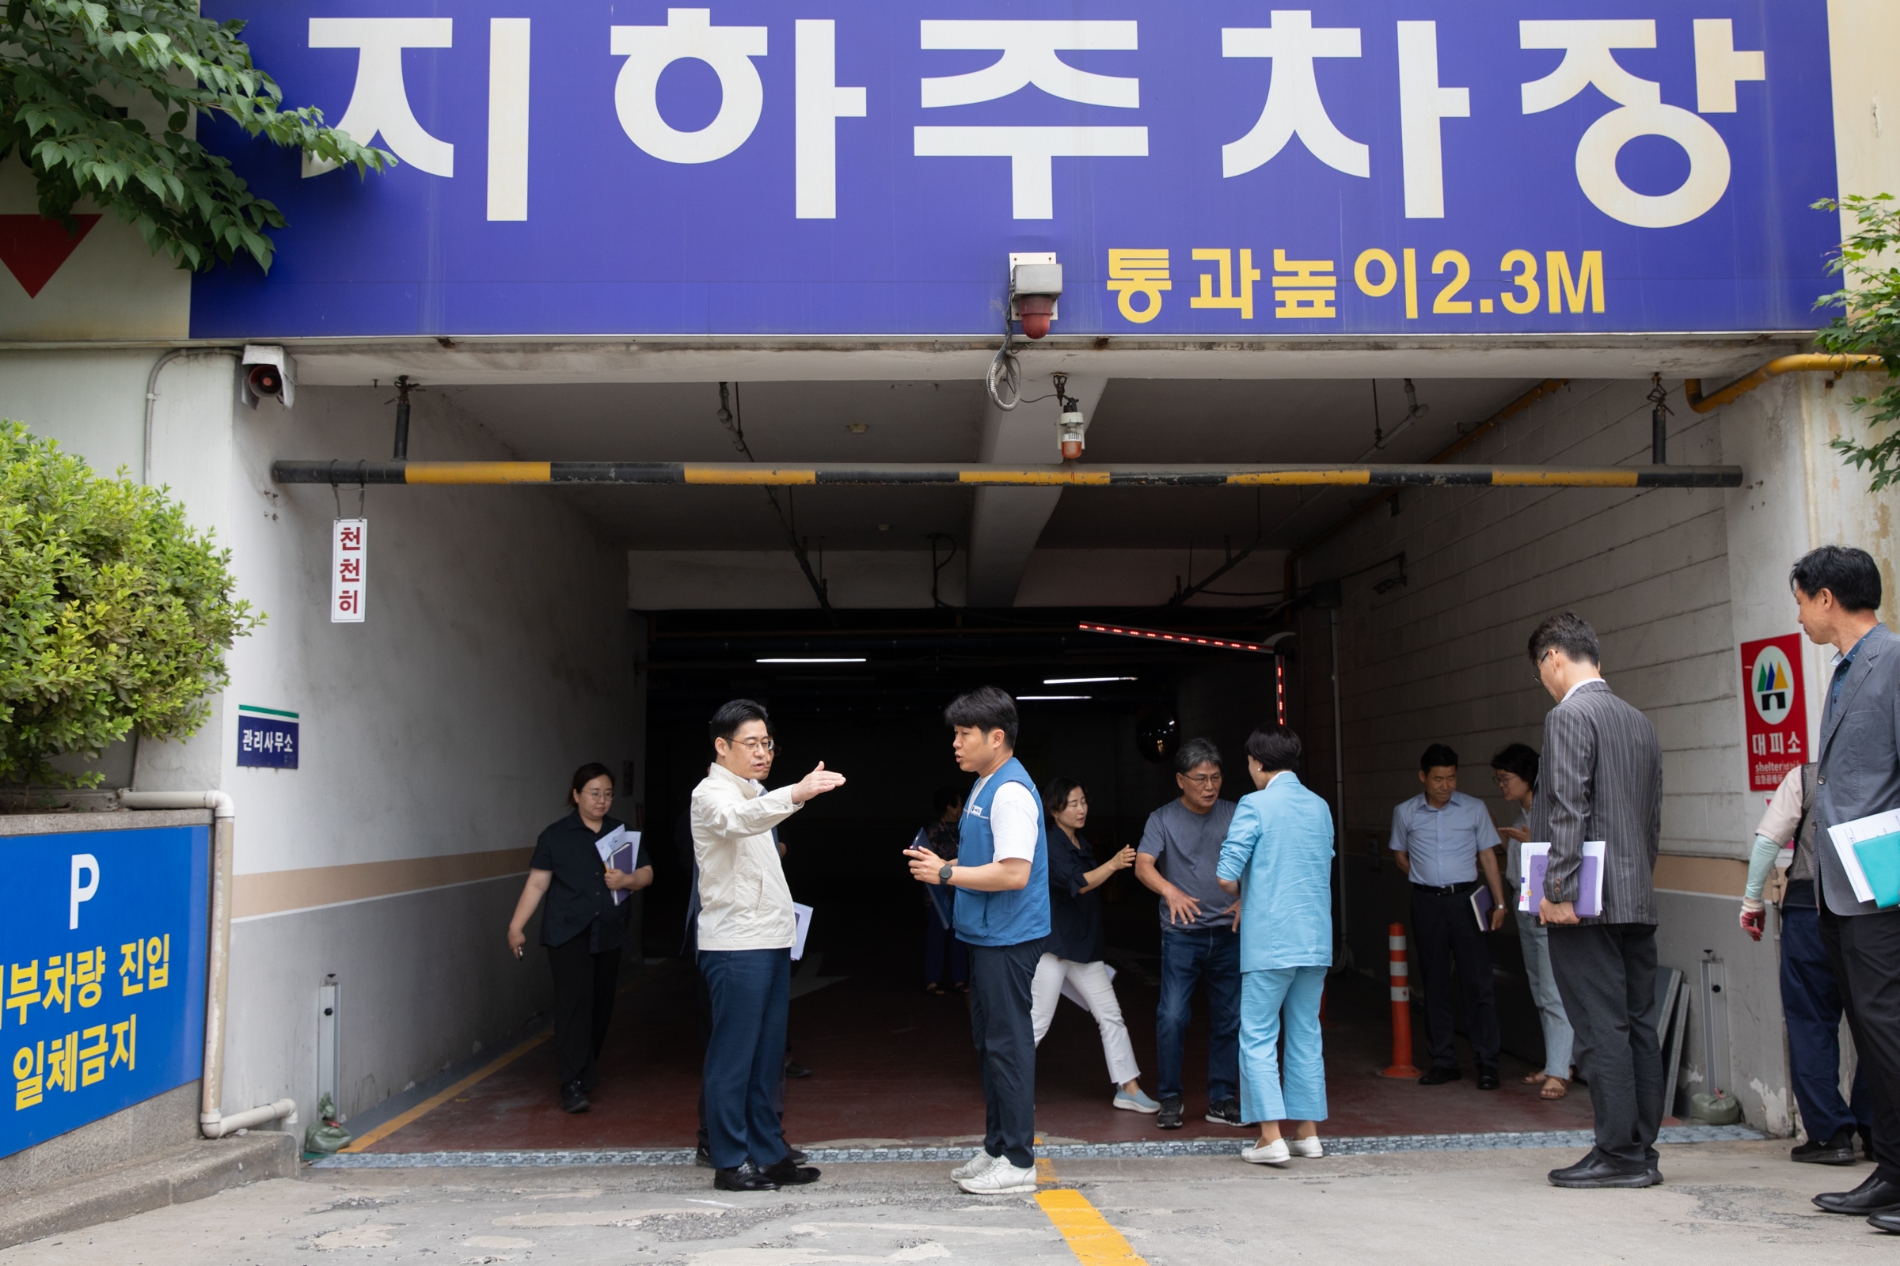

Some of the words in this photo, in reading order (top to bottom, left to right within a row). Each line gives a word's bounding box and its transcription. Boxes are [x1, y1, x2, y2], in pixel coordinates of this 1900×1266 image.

[301, 8, 1766, 228] 지하주차장
[339, 526, 361, 614] 천천히
[242, 729, 293, 753] 관리사무소
[1752, 731, 1802, 756] 대피소
[1755, 761, 1782, 773] shelter
[69, 853, 100, 930] P
[0, 946, 106, 1030] 부차량
[119, 933, 170, 997] 진입
[13, 1013, 137, 1111] 일체금지
